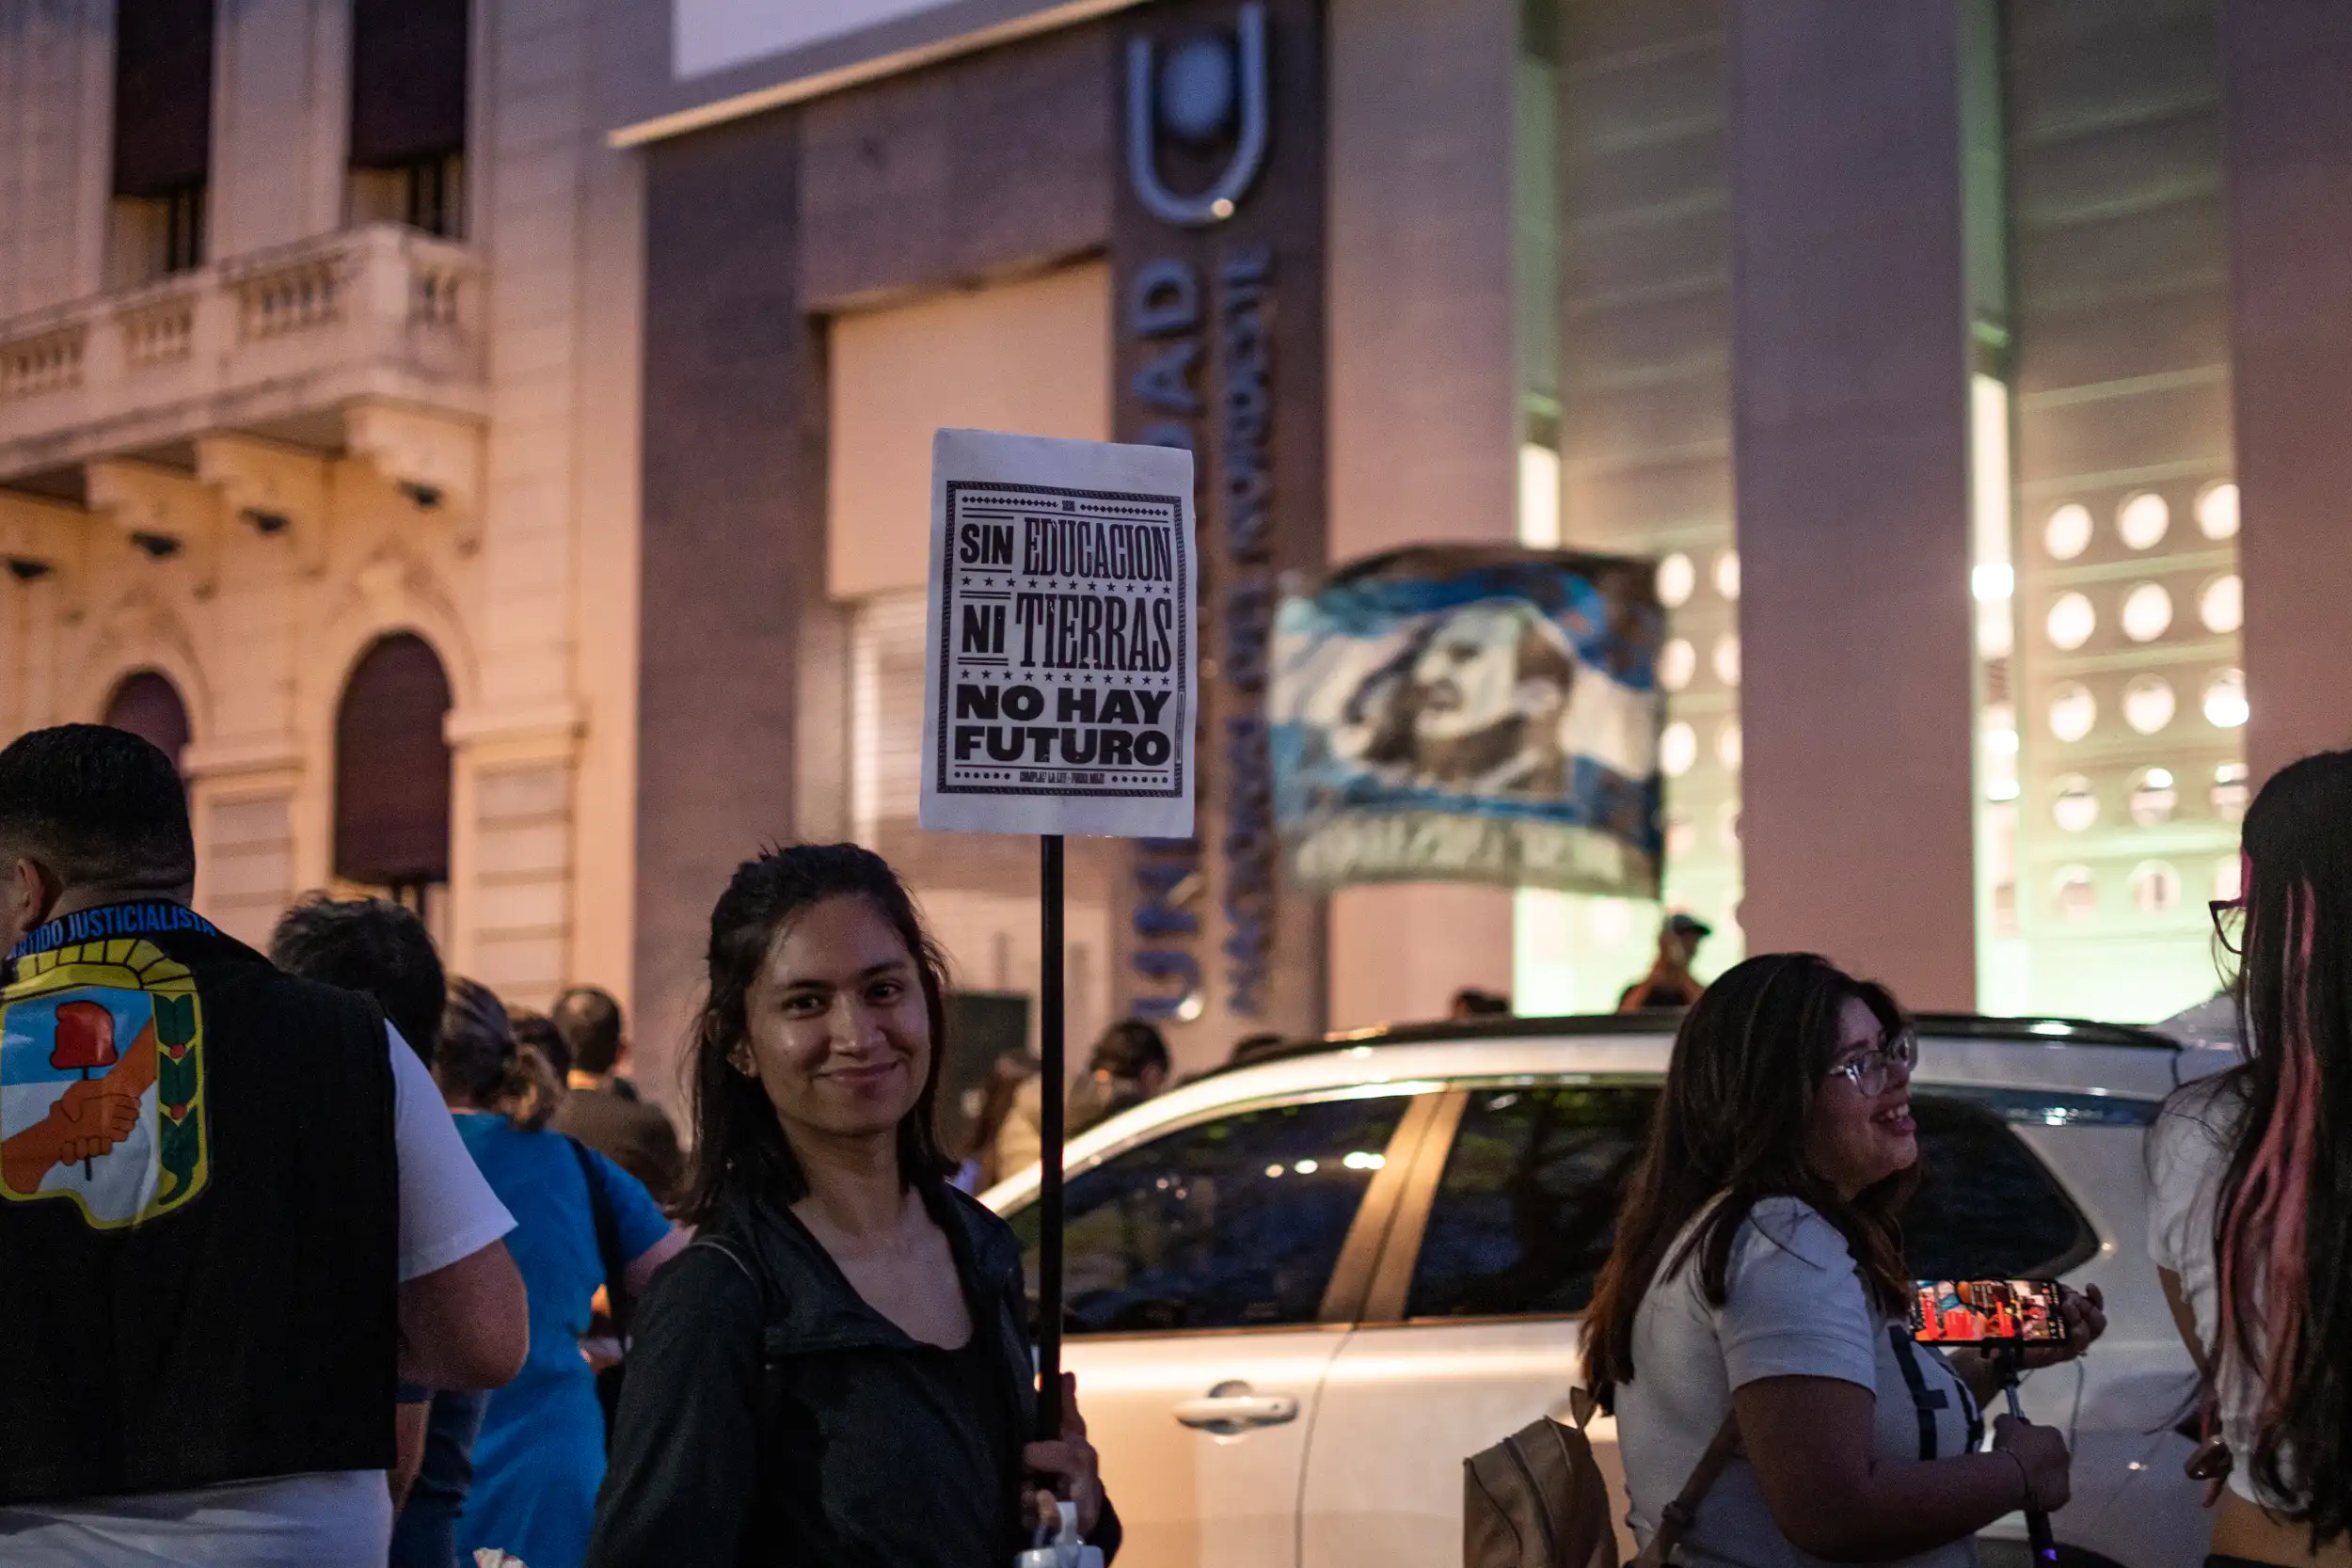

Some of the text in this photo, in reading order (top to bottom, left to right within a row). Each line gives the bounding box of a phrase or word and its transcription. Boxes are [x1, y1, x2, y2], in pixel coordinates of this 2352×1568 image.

[960, 517, 1173, 582] SIN EDUCACION
[961, 593, 1172, 673] NI TIERRAS
[956, 684, 1172, 725] NO HAY
[955, 725, 1171, 767] FUTURO
[7, 903, 216, 960] ARTIDO JUSTICIALISTA
